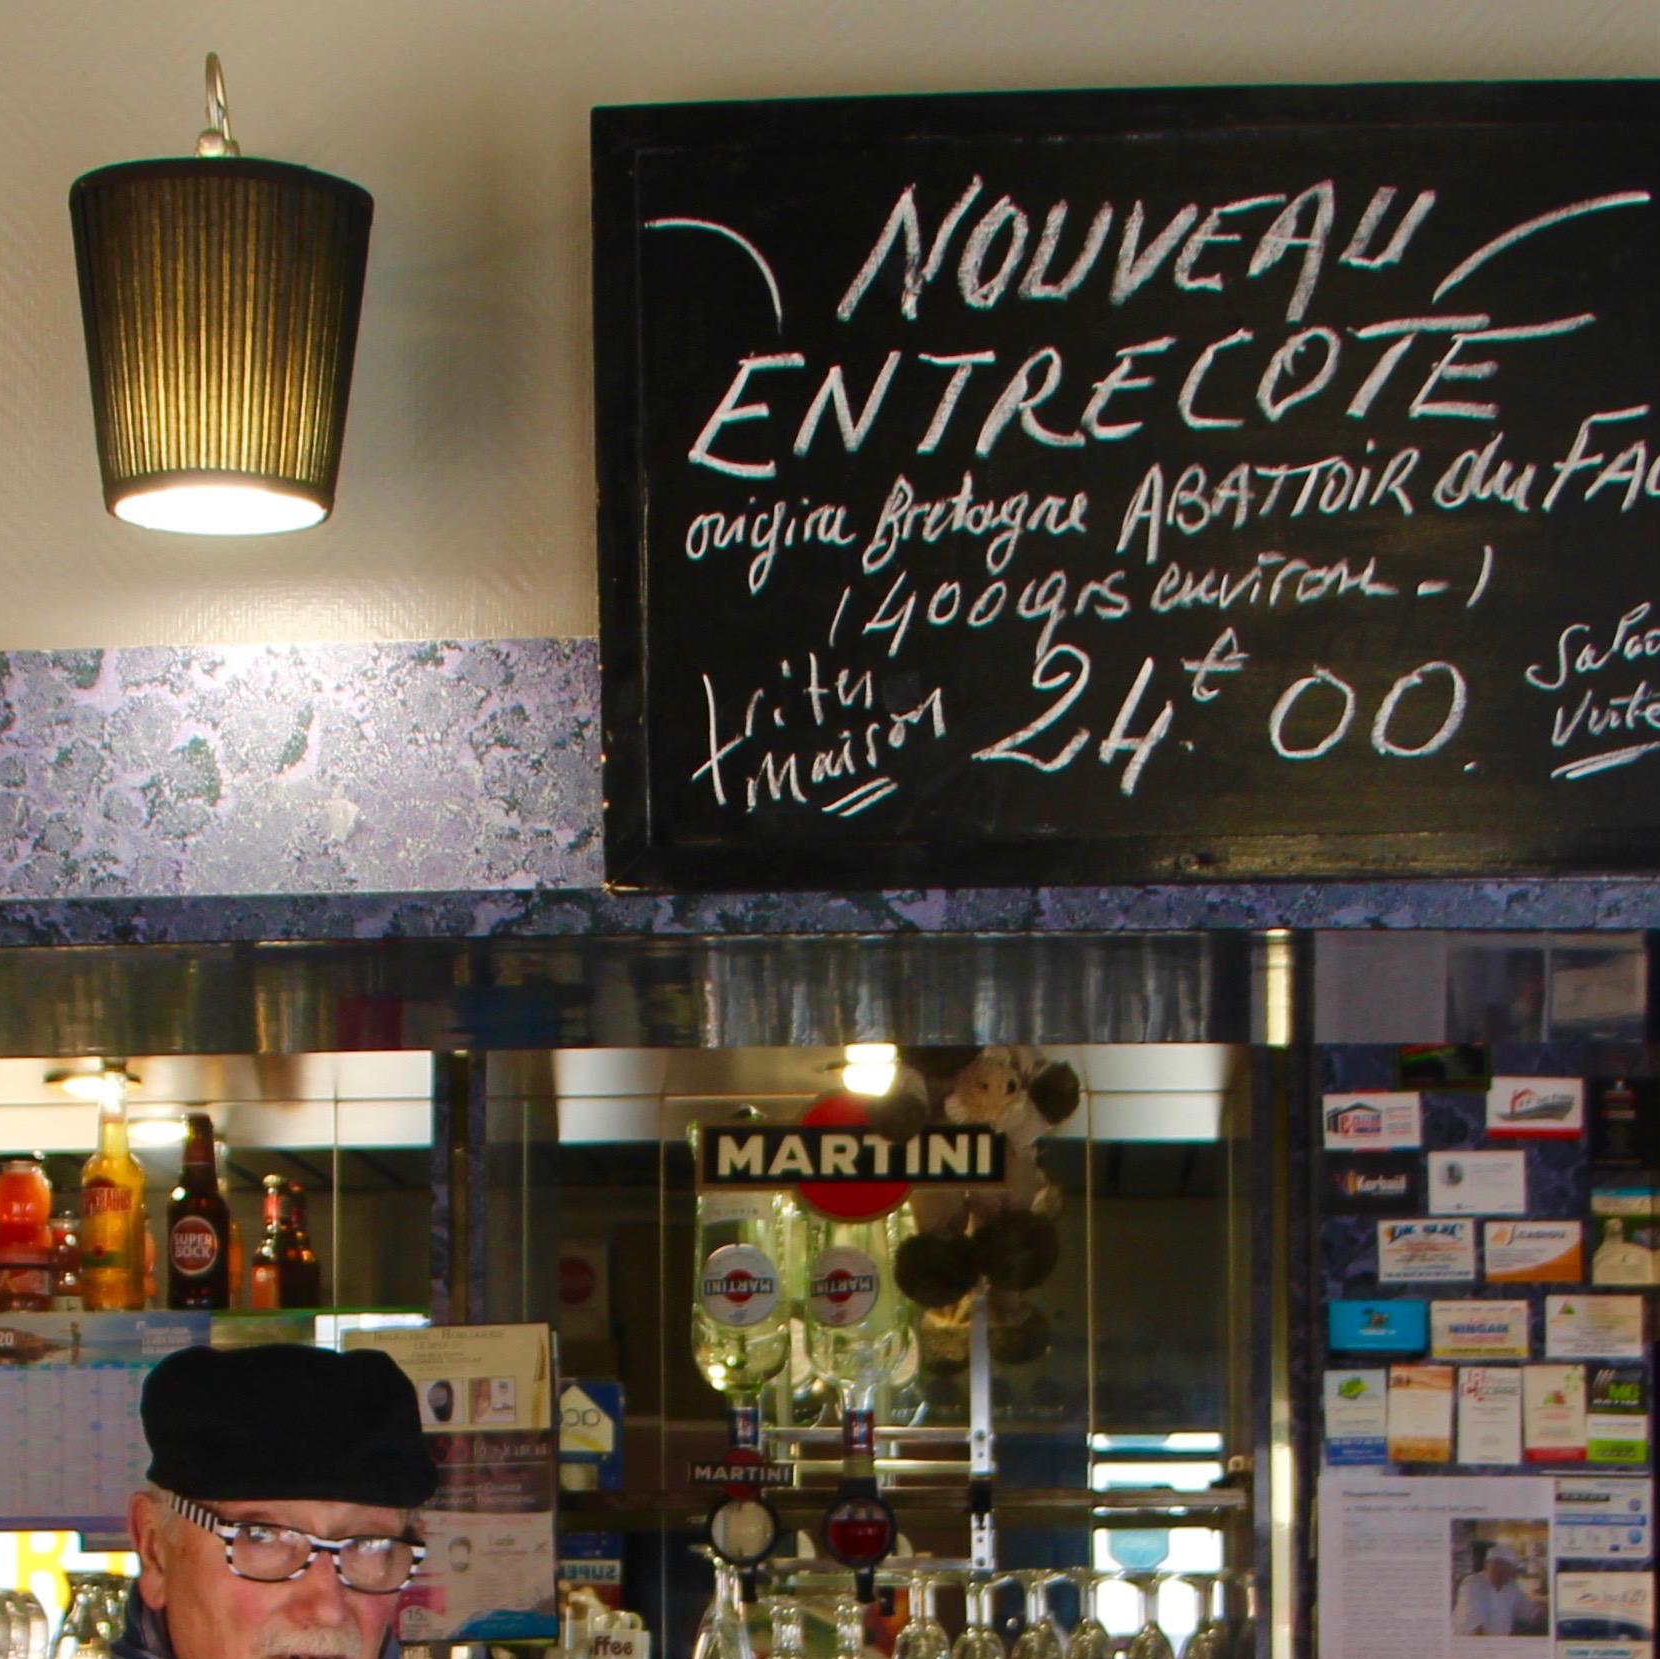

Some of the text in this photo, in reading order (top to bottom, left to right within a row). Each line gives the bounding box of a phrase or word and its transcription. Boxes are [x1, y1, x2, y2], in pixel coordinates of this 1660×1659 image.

[835, 173, 1437, 322] NOUVEAU
[686, 312, 1596, 478] ENTRECOTE
[862, 473, 1089, 574] Bretagne
[1432, 429, 1536, 514] du
[716, 1133, 993, 1177] MARTINI
[174, 1233, 213, 1246] SUPER
[175, 1245, 211, 1258] BOCK
[694, 1466, 791, 1481] MARTINI
